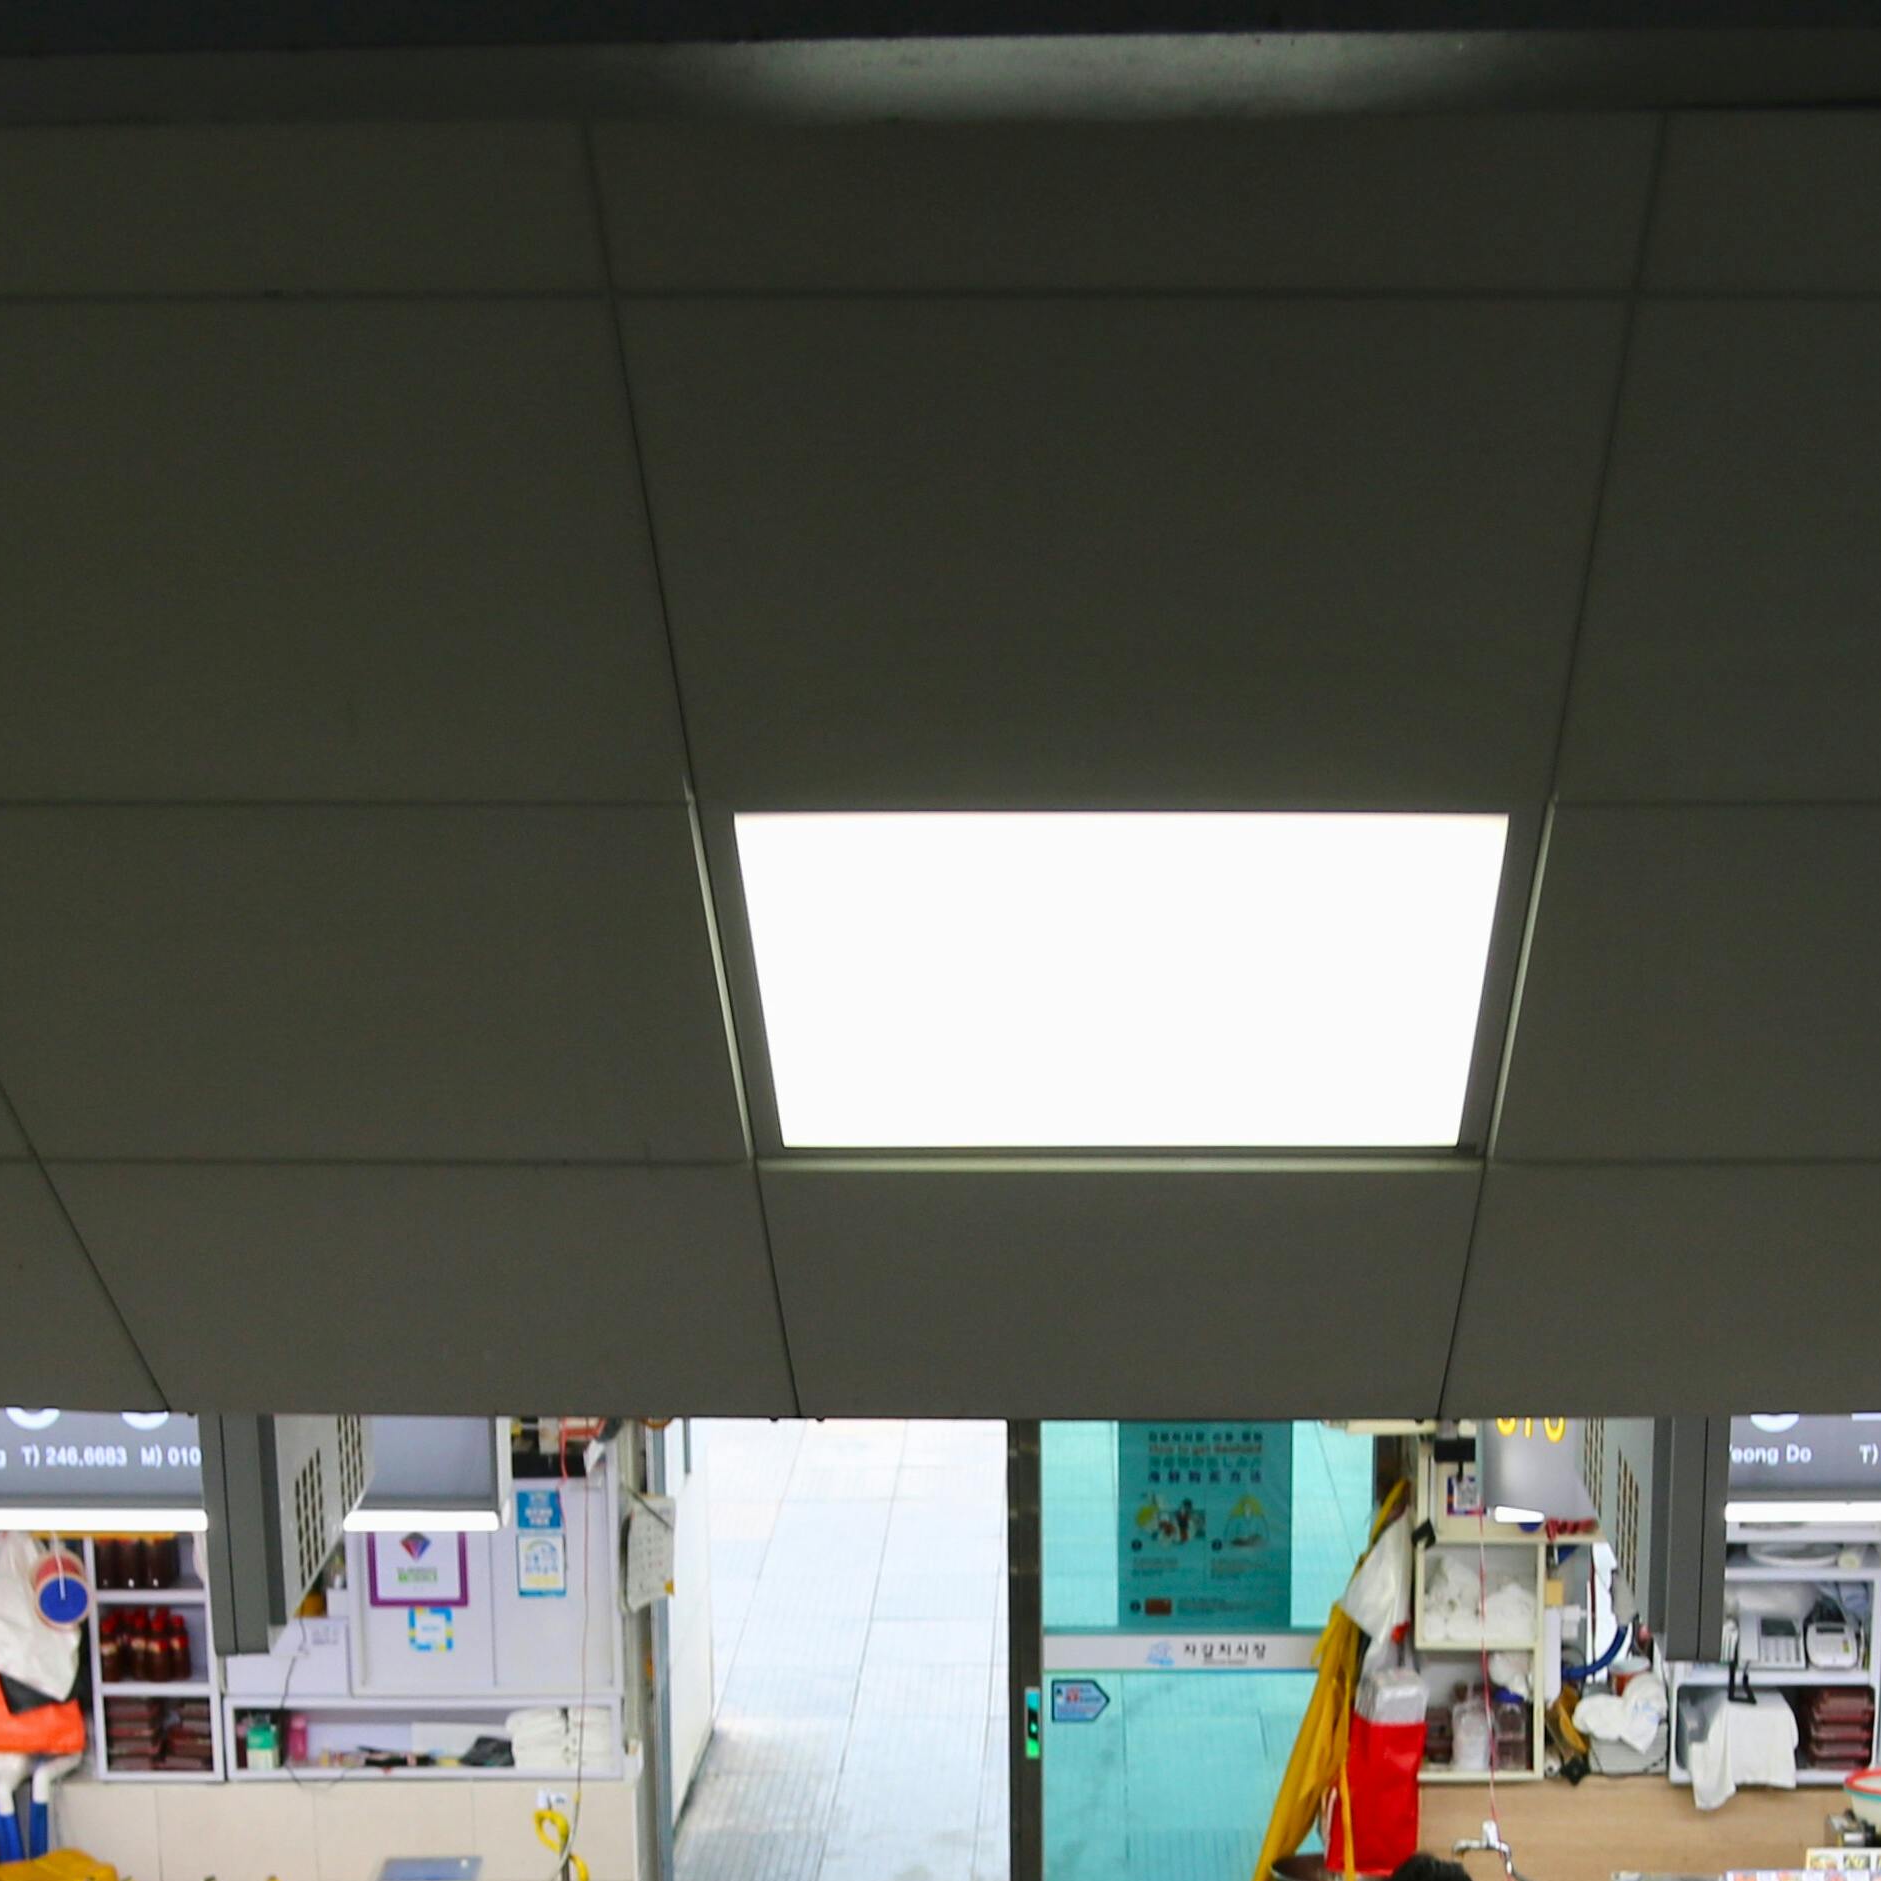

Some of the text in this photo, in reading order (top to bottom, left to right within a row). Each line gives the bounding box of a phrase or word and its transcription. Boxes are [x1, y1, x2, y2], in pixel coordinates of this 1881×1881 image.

[21, 1444, 40, 1467] T)
[140, 1444, 163, 1467] M)
[167, 1445, 202, 1467] 010
[1729, 1443, 1779, 1467] eong
[1786, 1443, 1812, 1464] Do
[1859, 1443, 1878, 1465] T)
[1184, 1642, 1266, 1659] 자갈치시장
